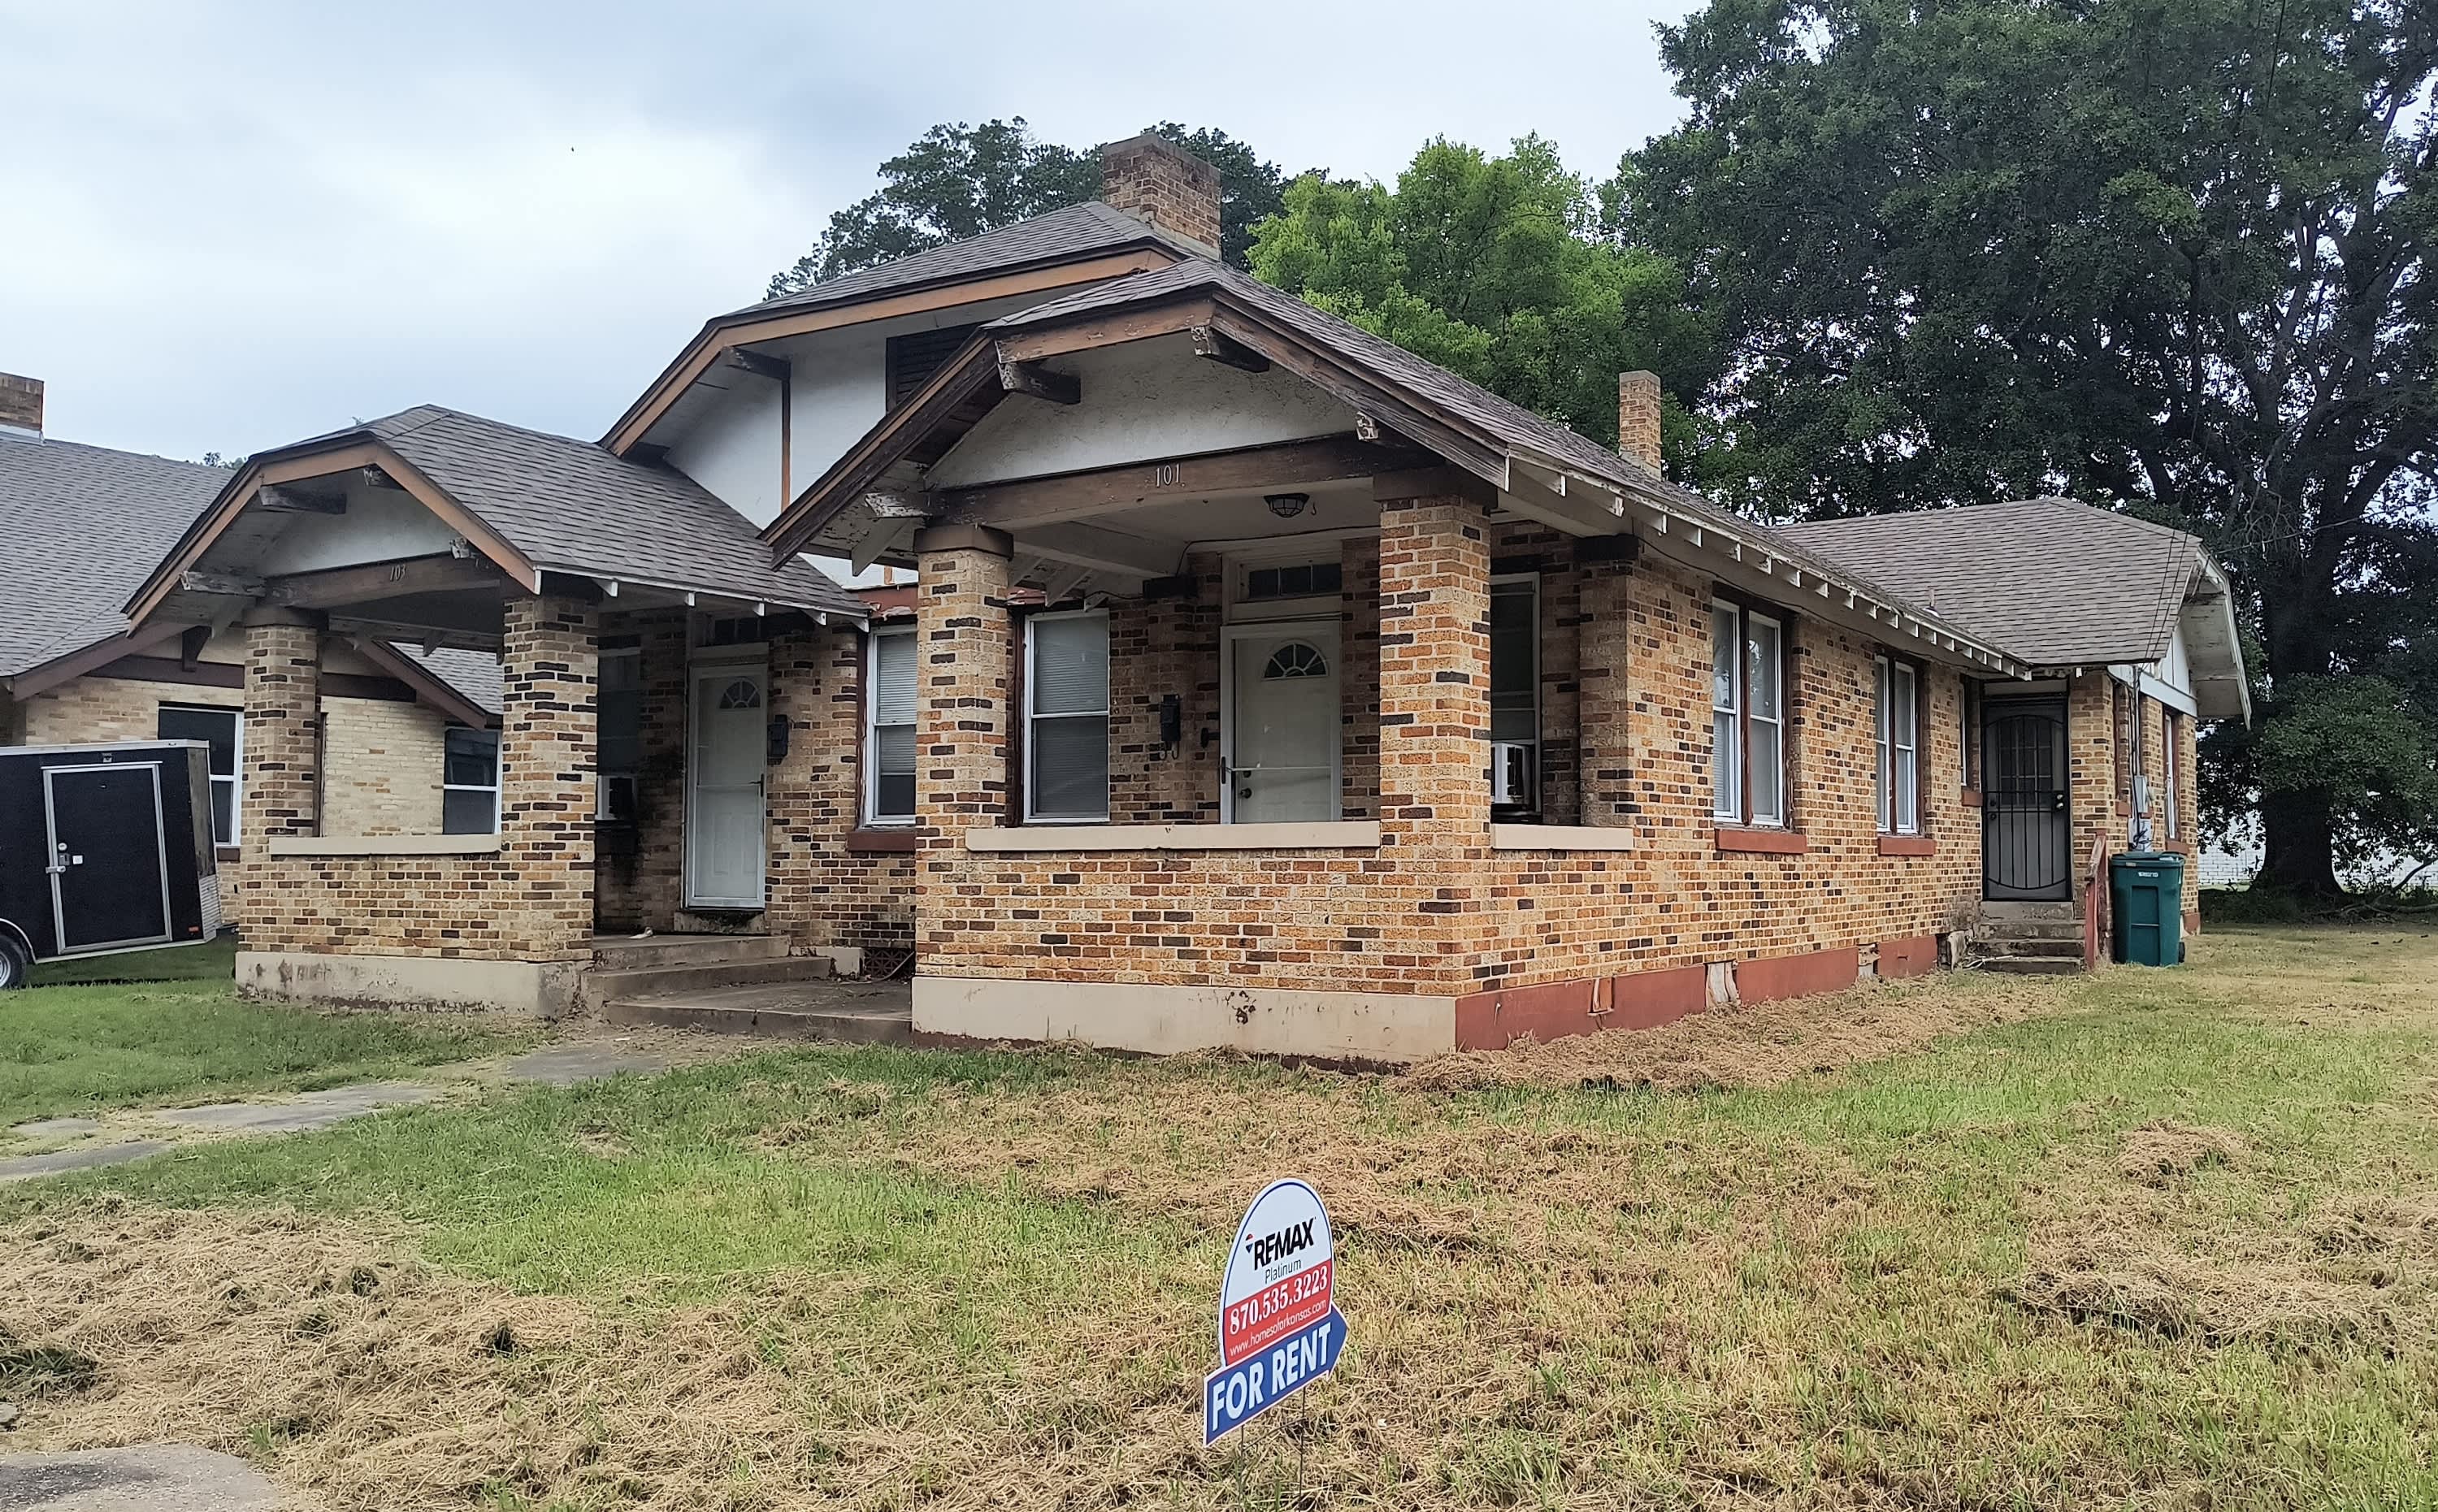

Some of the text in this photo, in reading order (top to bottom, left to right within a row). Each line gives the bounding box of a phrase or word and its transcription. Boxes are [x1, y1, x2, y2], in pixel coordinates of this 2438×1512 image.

[1156, 463, 1179, 487] 101
[390, 564, 406, 581] 103
[1265, 1259, 1301, 1284] Platinum
[1230, 1265, 1328, 1335] 870.535.3223
[1230, 1299, 1327, 1357] www.homesofarkansas.com
[1212, 1322, 1331, 1432] FOR RENT
